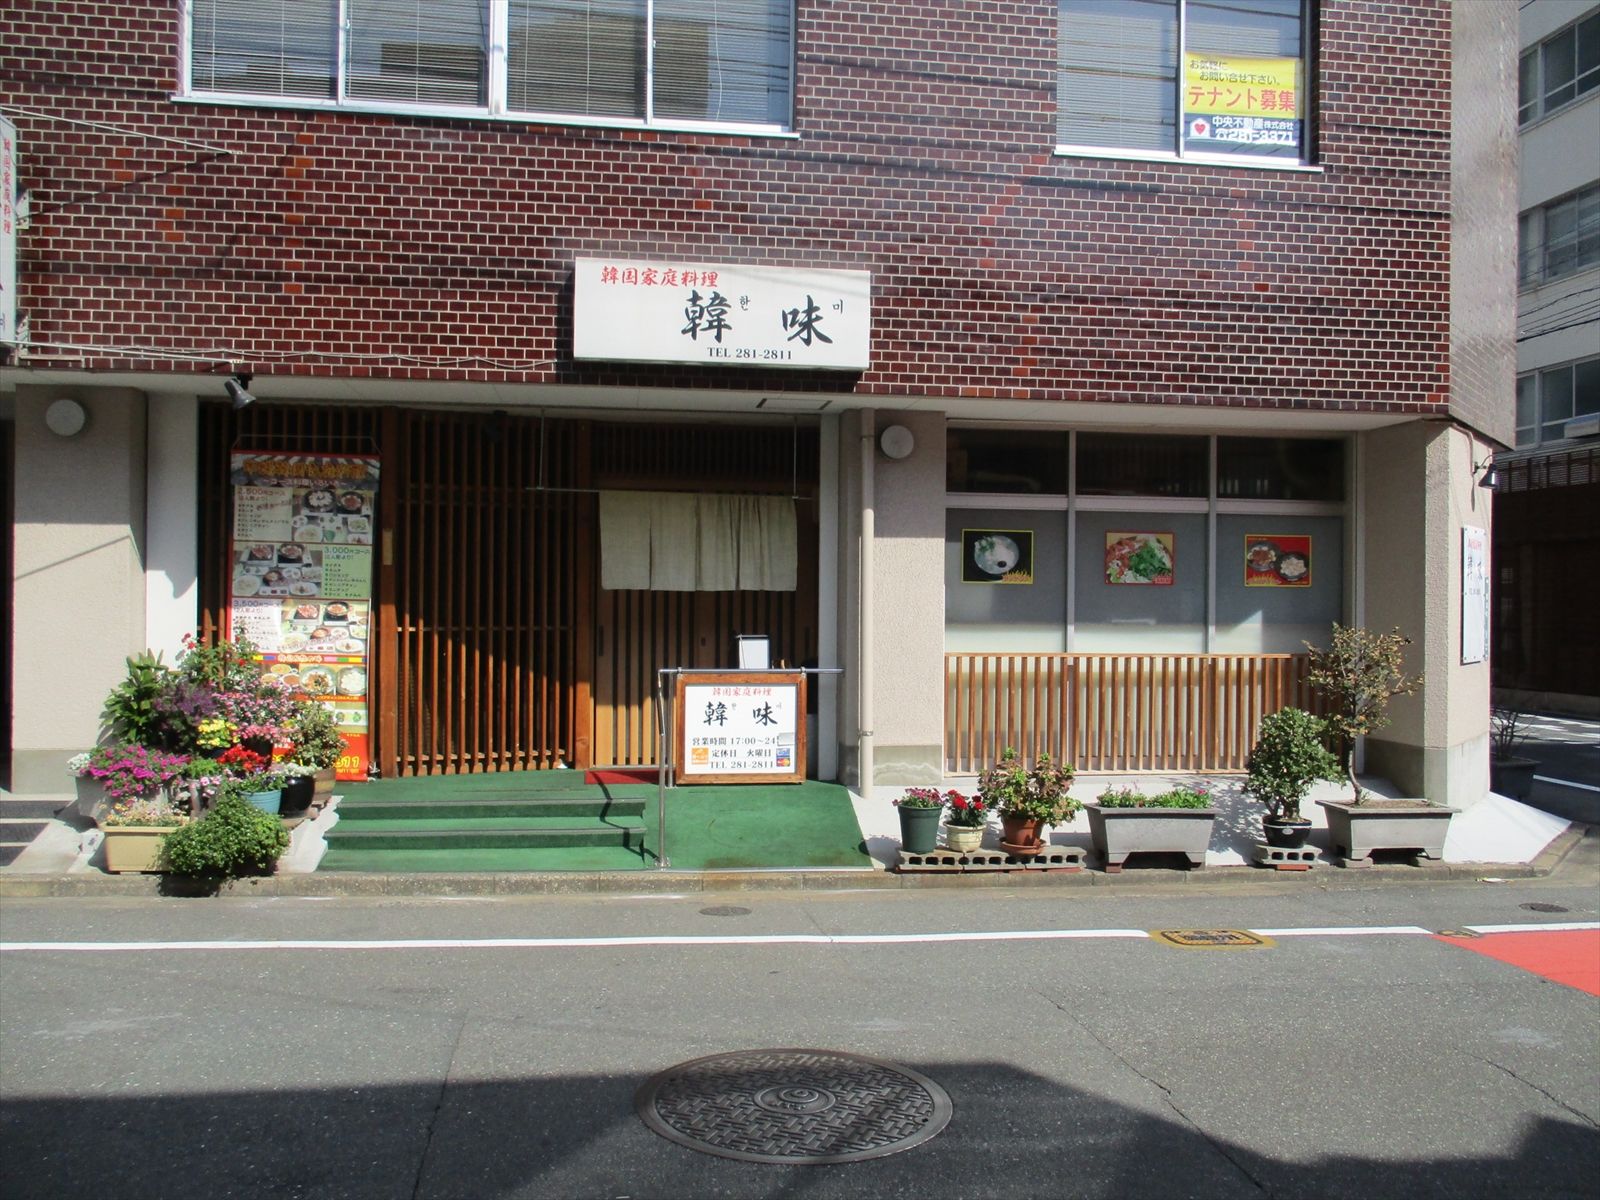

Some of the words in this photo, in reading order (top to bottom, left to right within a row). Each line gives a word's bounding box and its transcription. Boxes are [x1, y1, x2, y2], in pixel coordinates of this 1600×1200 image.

[1188, 86, 1295, 110] テナント募集
[600, 265, 719, 288] 韓国家庭料理
[681, 289, 732, 344] 韓
[782, 294, 833, 347] 味
[707, 346, 731, 359] TEL
[735, 348, 793, 361] 281-2811
[713, 687, 772, 697] 韓国家庭料理
[703, 701, 728, 727] 韓
[752, 701, 778, 727] 味
[692, 736, 727, 746] 営業時間
[711, 748, 737, 758] 定休日
[746, 748, 772, 758] 火曜日
[730, 761, 774, 769] 281-2811
